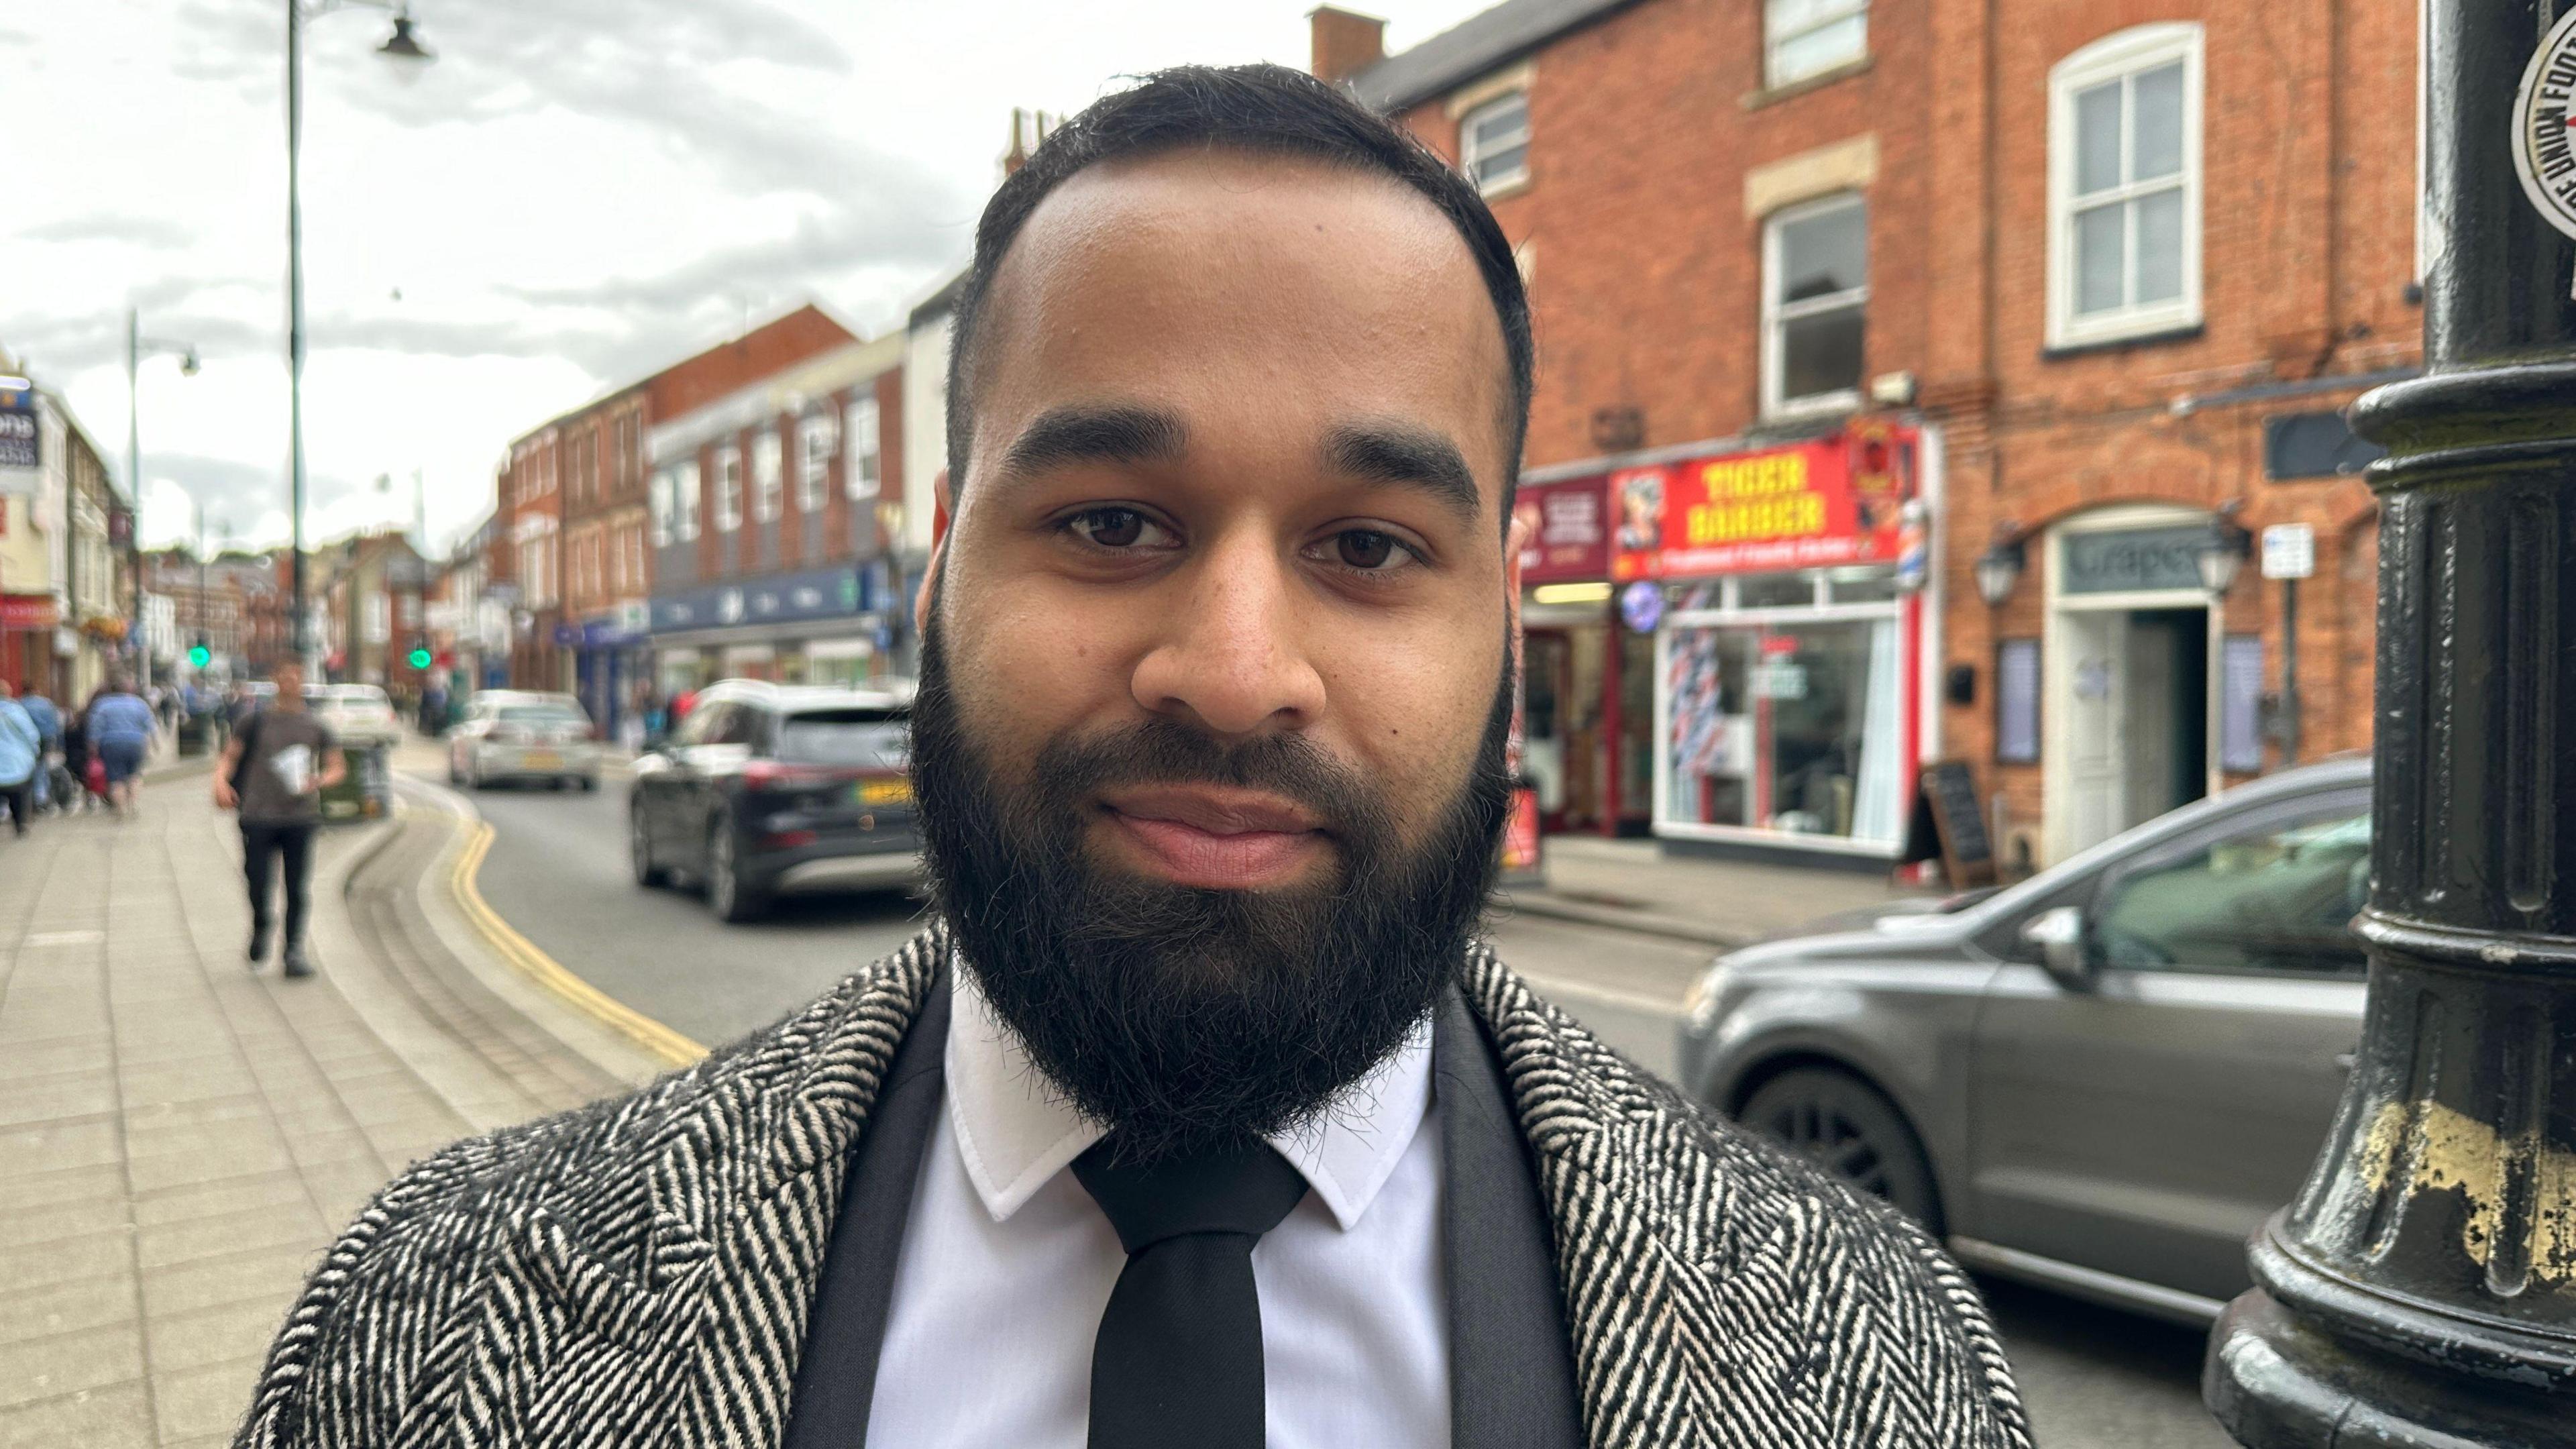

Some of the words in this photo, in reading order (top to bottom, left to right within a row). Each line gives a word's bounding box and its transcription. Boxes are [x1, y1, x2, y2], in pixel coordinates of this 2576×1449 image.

[2534, 105, 2576, 180] UNION
[1701, 451, 1806, 499] TIGER
[1687, 492, 1825, 545] BARBER
